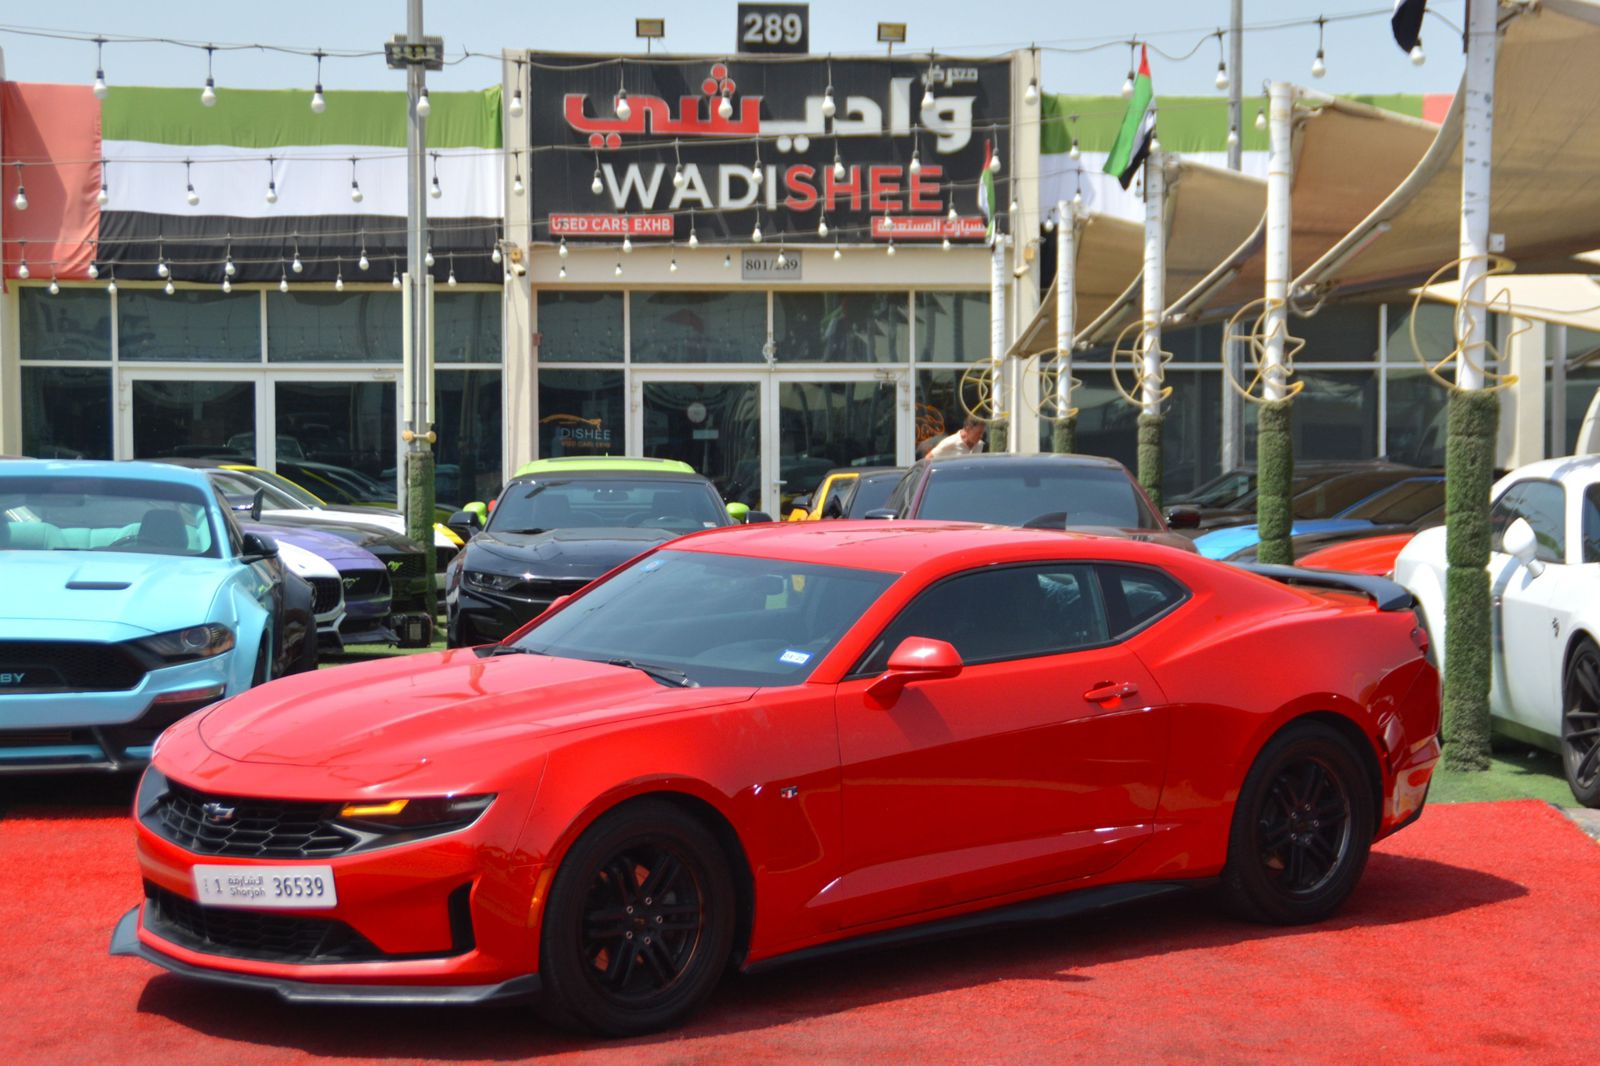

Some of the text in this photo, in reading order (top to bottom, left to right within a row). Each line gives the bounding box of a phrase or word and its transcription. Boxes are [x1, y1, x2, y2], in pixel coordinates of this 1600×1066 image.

[743, 13, 802, 43] 289
[601, 163, 943, 211] WADISHEE
[551, 217, 671, 232] USED CARS EXHB
[230, 886, 265, 898] Sharjah
[273, 876, 325, 897] 36539
